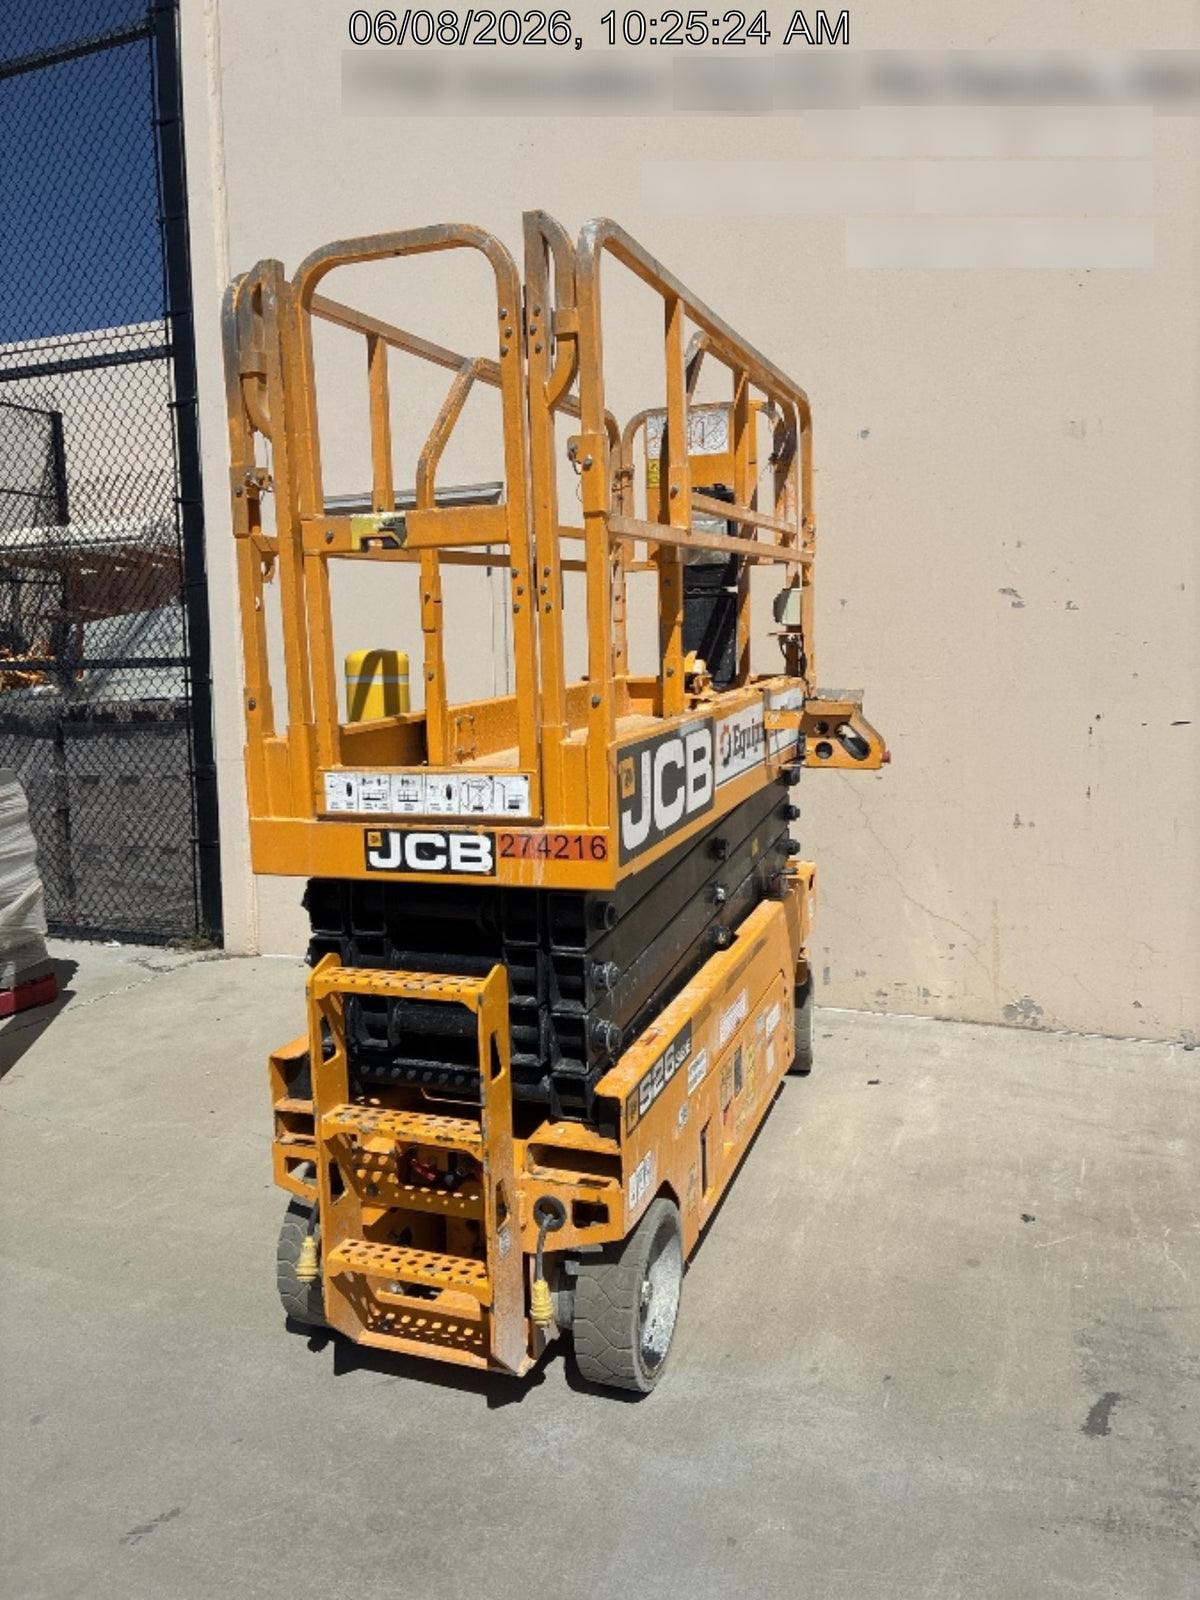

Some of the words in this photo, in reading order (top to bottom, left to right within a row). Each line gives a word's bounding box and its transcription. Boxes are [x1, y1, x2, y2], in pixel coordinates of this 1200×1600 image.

[621, 728, 714, 851] JCB
[367, 831, 494, 873] JCB
[500, 833, 608, 861] 274216
